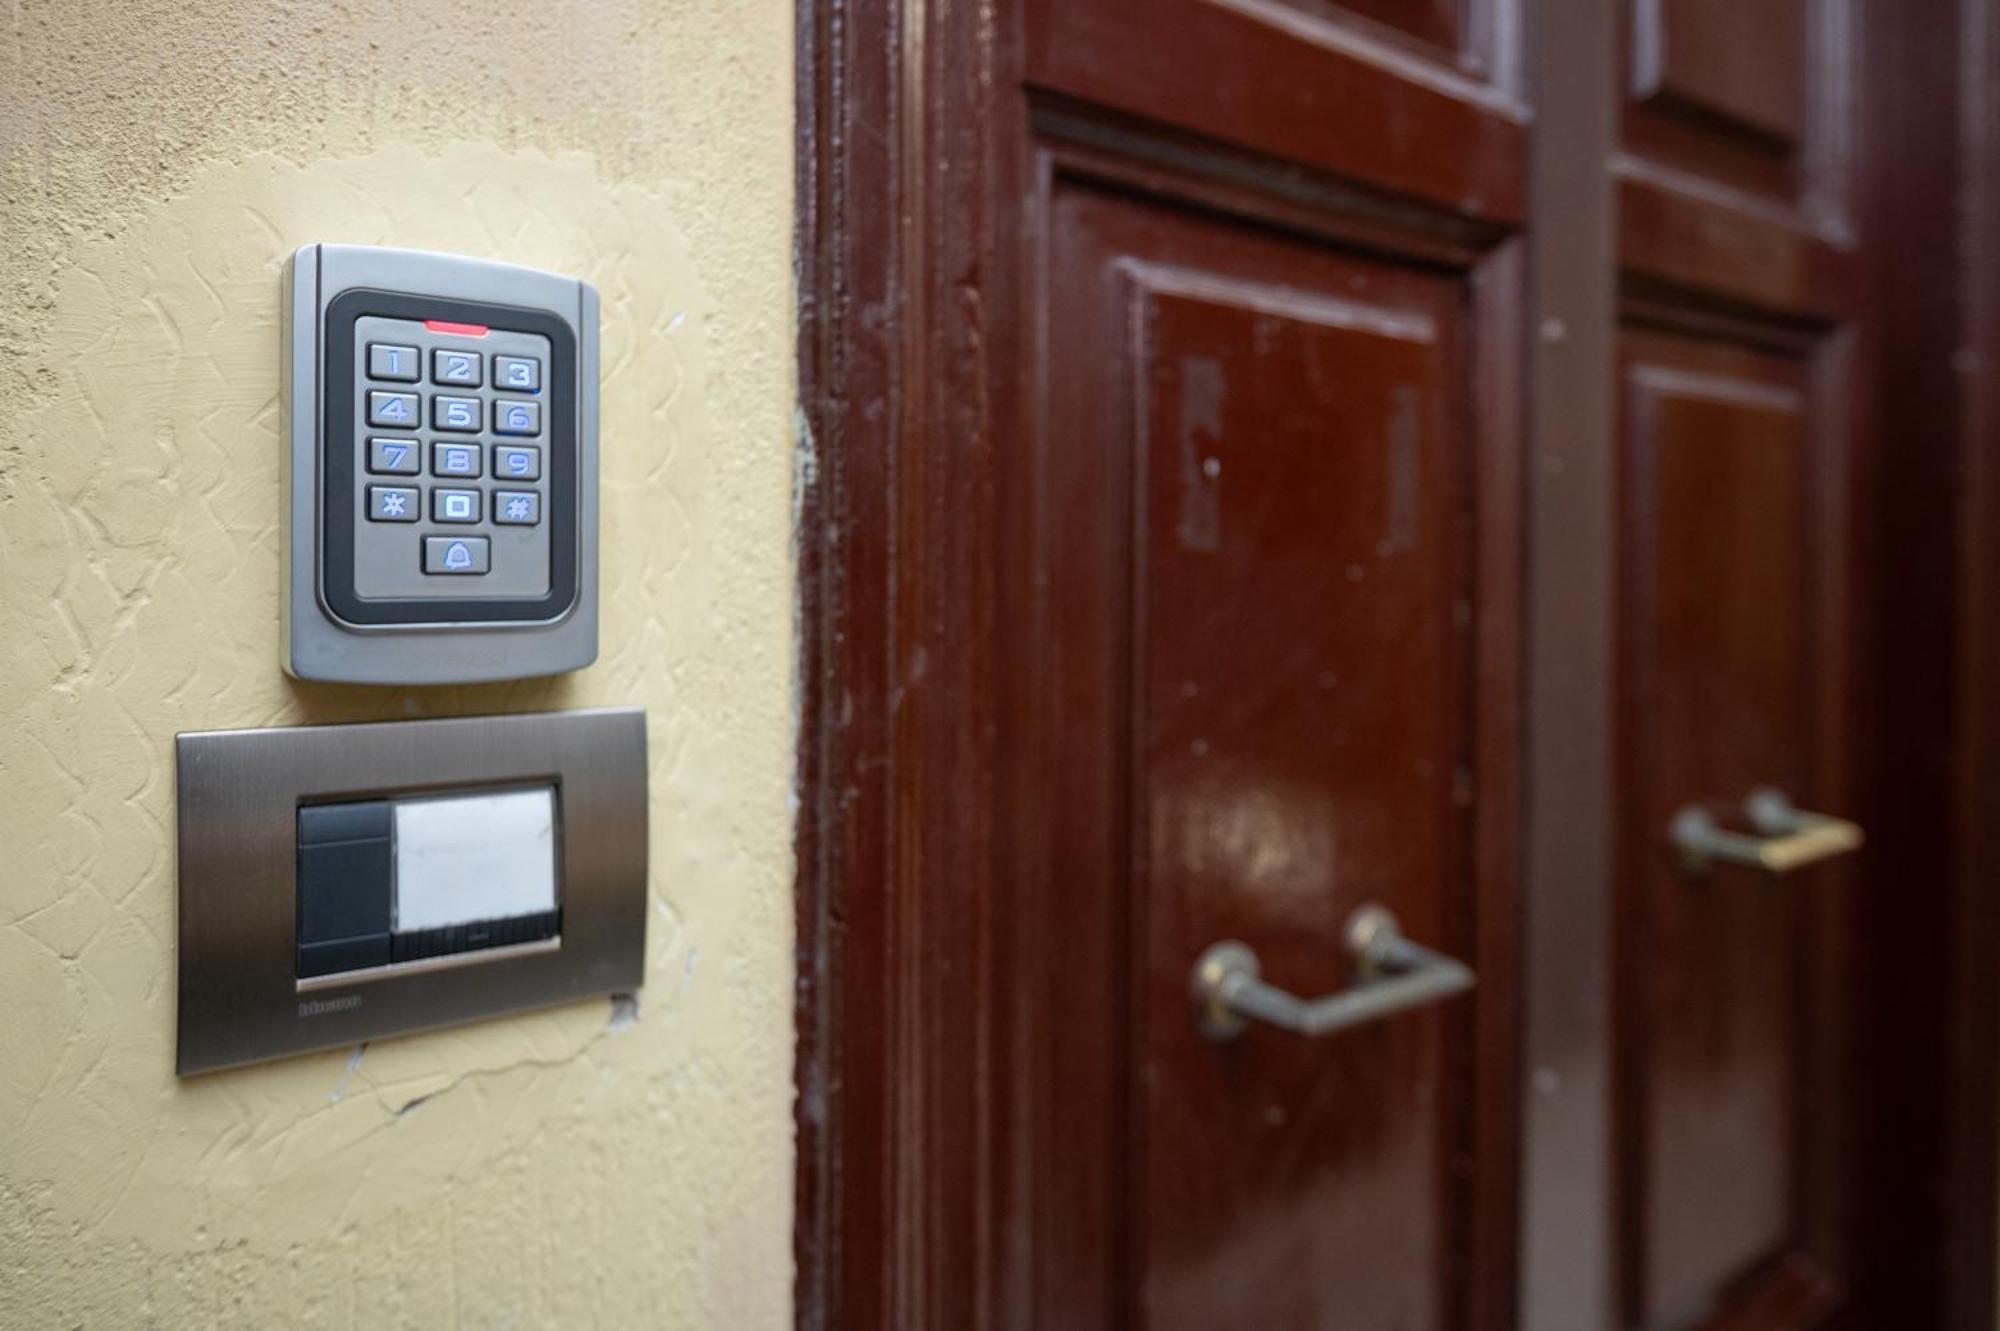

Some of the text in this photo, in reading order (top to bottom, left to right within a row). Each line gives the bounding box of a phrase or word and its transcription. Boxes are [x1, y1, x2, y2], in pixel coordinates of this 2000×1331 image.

[387, 350, 530, 387] 1 2 3
[379, 397, 529, 429] 4 5 6
[383, 445, 529, 475] 7 8 9
[445, 494, 470, 518] 0
[506, 496, 530, 519] #
